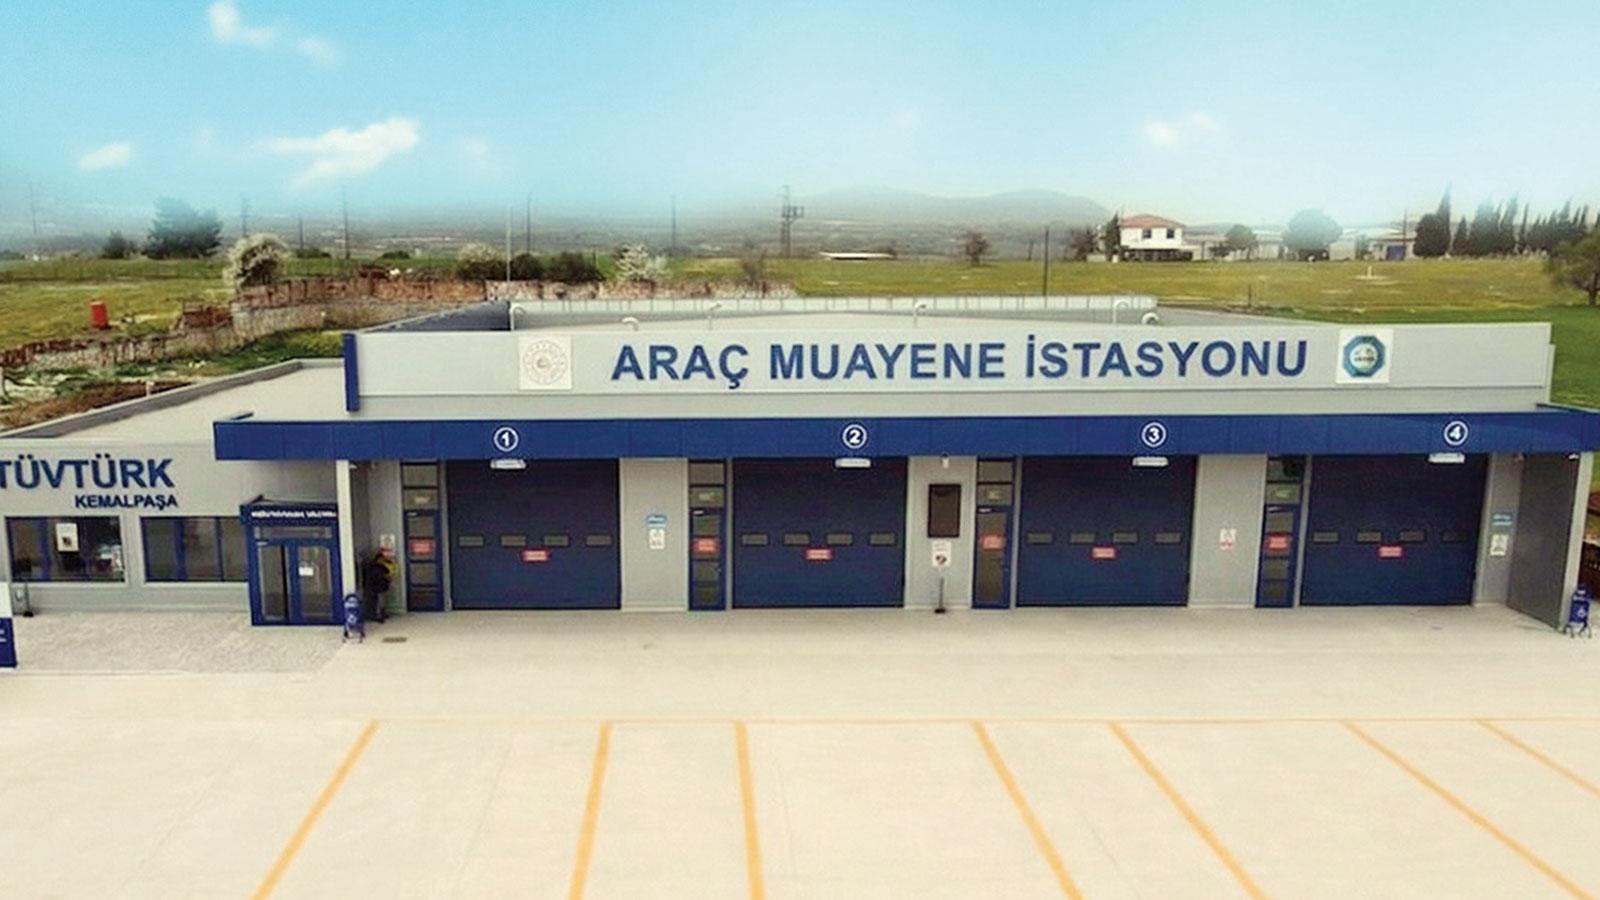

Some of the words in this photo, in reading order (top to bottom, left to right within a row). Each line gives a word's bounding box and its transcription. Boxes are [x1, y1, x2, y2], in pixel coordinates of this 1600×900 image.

[611, 344, 748, 390] ARAÇ
[769, 343, 1005, 380] MUAYENE
[1025, 334, 1308, 378] İSTASYONU
[502, 432, 510, 446] 1
[849, 429, 861, 444] 2
[1149, 428, 1160, 443] 3
[1450, 426, 1461, 440] 4
[0, 453, 175, 489] TÜVTÜRK
[75, 494, 178, 511] KEMALPAŞA
